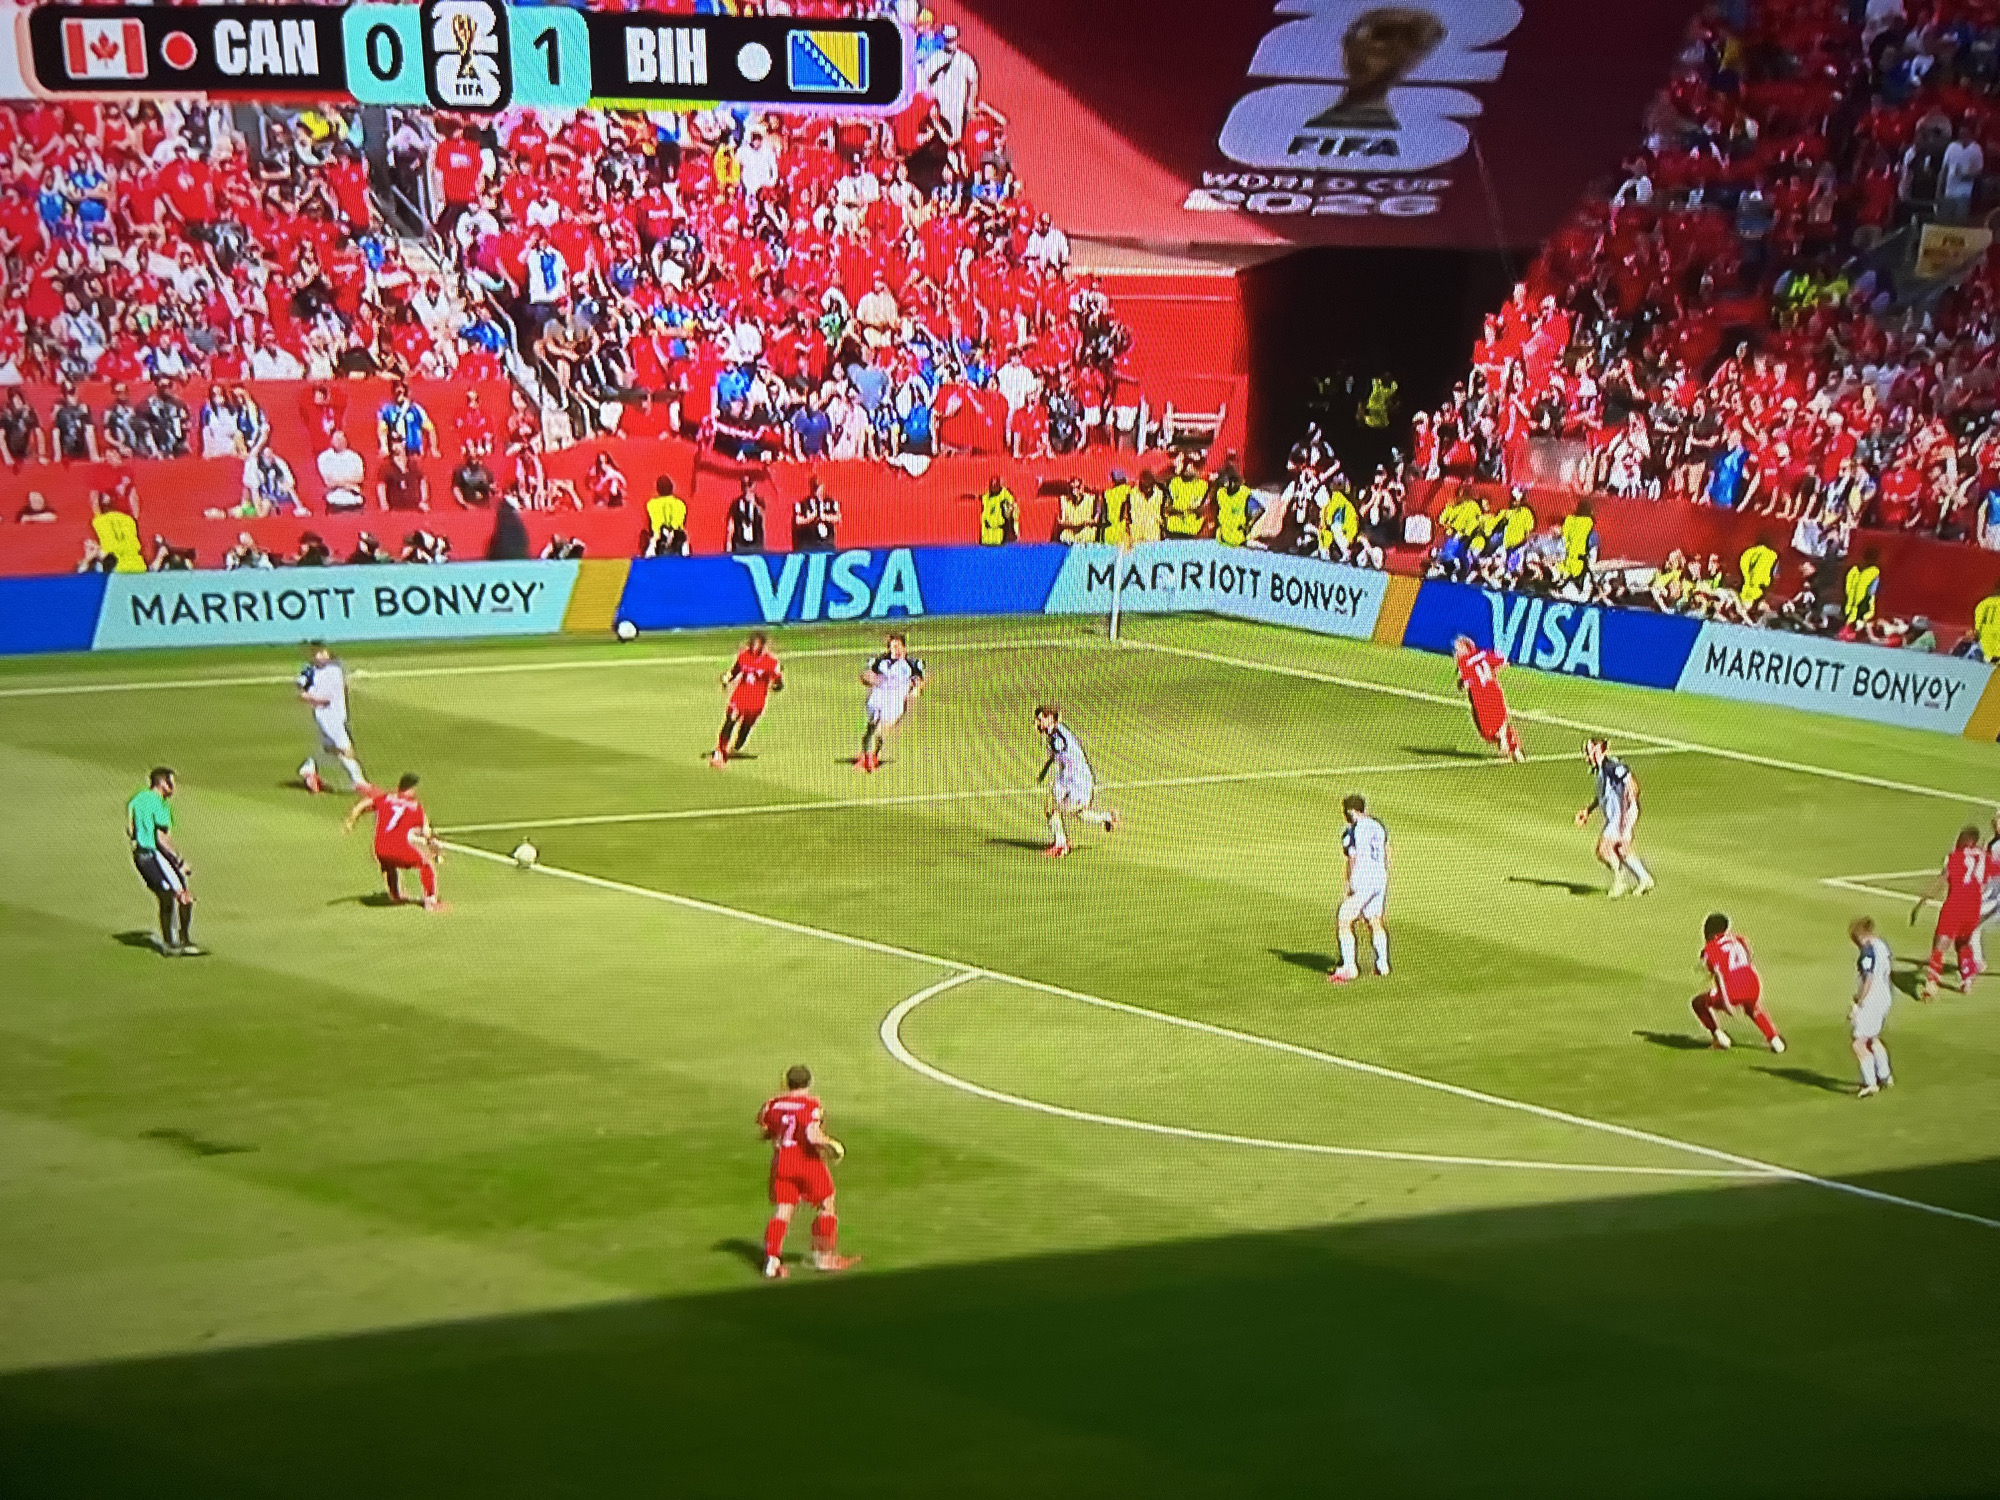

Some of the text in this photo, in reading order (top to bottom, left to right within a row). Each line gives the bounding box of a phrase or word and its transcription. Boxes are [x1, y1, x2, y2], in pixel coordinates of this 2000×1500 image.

[214, 19, 319, 76] CAN
[366, 23, 403, 81] 0
[533, 26, 560, 86] 1
[625, 26, 707, 84] BIH
[456, 84, 483, 97] FIFA
[1287, 134, 1401, 157] FIFA
[1183, 187, 1442, 217] 2026
[1202, 170, 1453, 193] WORLD CUP
[131, 581, 541, 626] MARRIOTT BONVOY
[732, 548, 925, 623] VISA
[1270, 571, 1364, 618] BONVOY
[1482, 588, 1600, 678] VISA
[1704, 642, 1961, 711] MARRIOTT BONVOY
[385, 804, 407, 833] 7
[781, 1113, 798, 1148] 2
